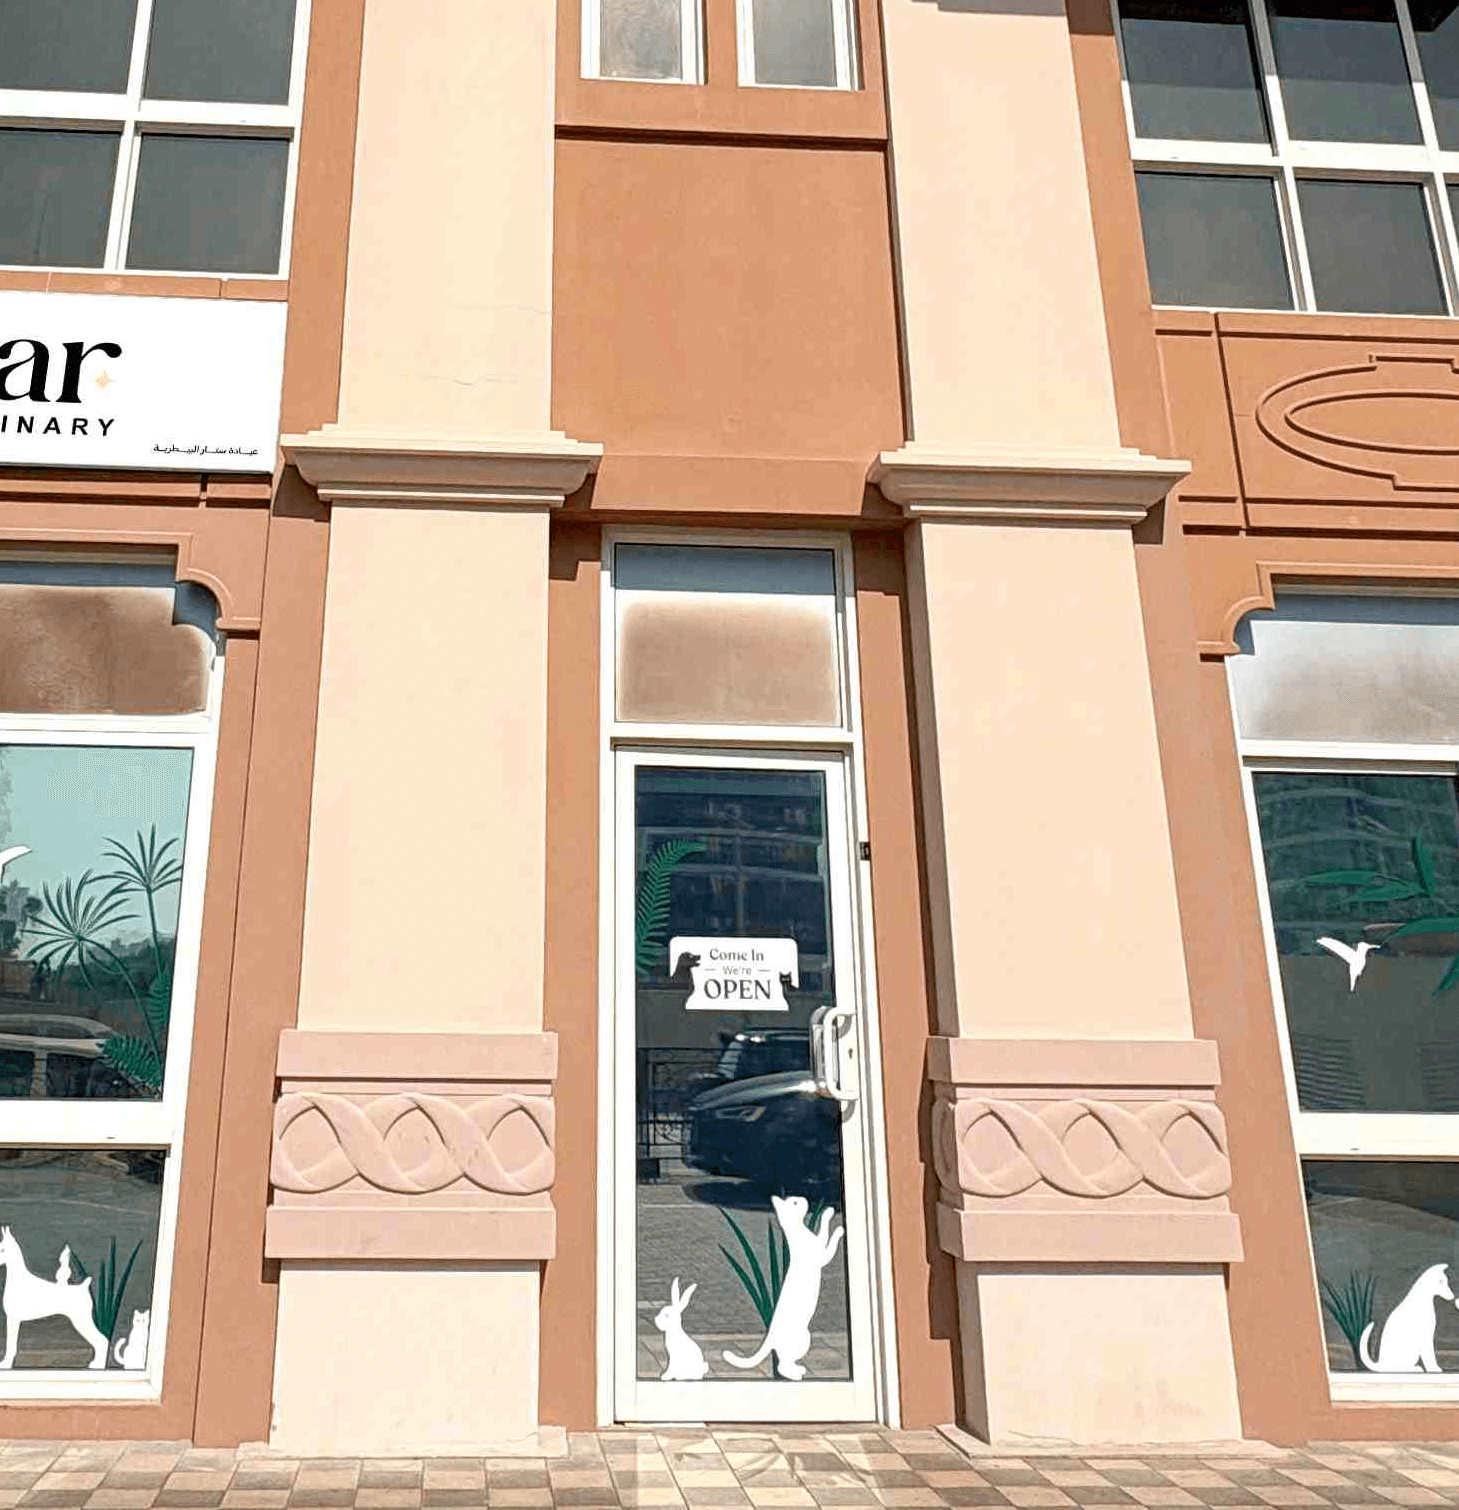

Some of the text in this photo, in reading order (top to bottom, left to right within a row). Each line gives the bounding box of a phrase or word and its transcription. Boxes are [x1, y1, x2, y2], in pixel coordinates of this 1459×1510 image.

[709, 948, 764, 962] Come In
[722, 965, 752, 976] We're
[704, 979, 770, 999] OPEN
